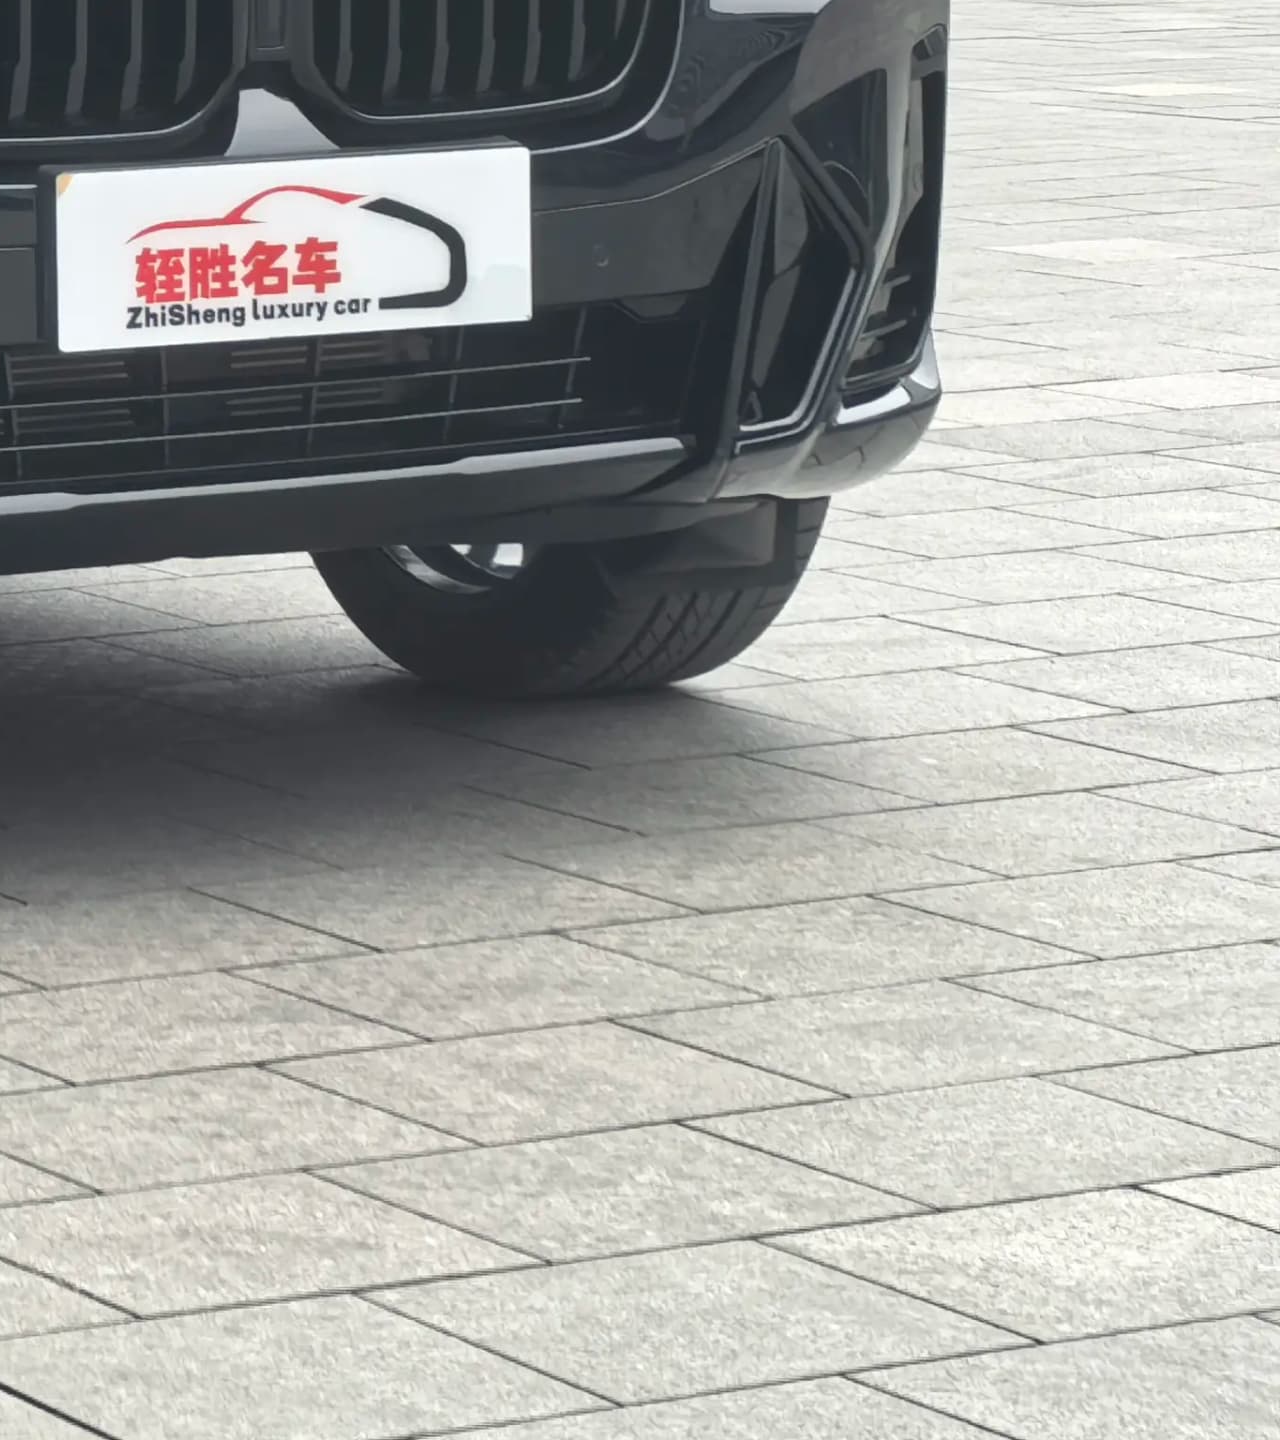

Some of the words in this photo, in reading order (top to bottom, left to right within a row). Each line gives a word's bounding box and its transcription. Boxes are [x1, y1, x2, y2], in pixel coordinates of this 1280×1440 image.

[125, 303, 246, 329] ZhiSheng
[251, 298, 329, 322] luxury
[333, 297, 372, 316] car
